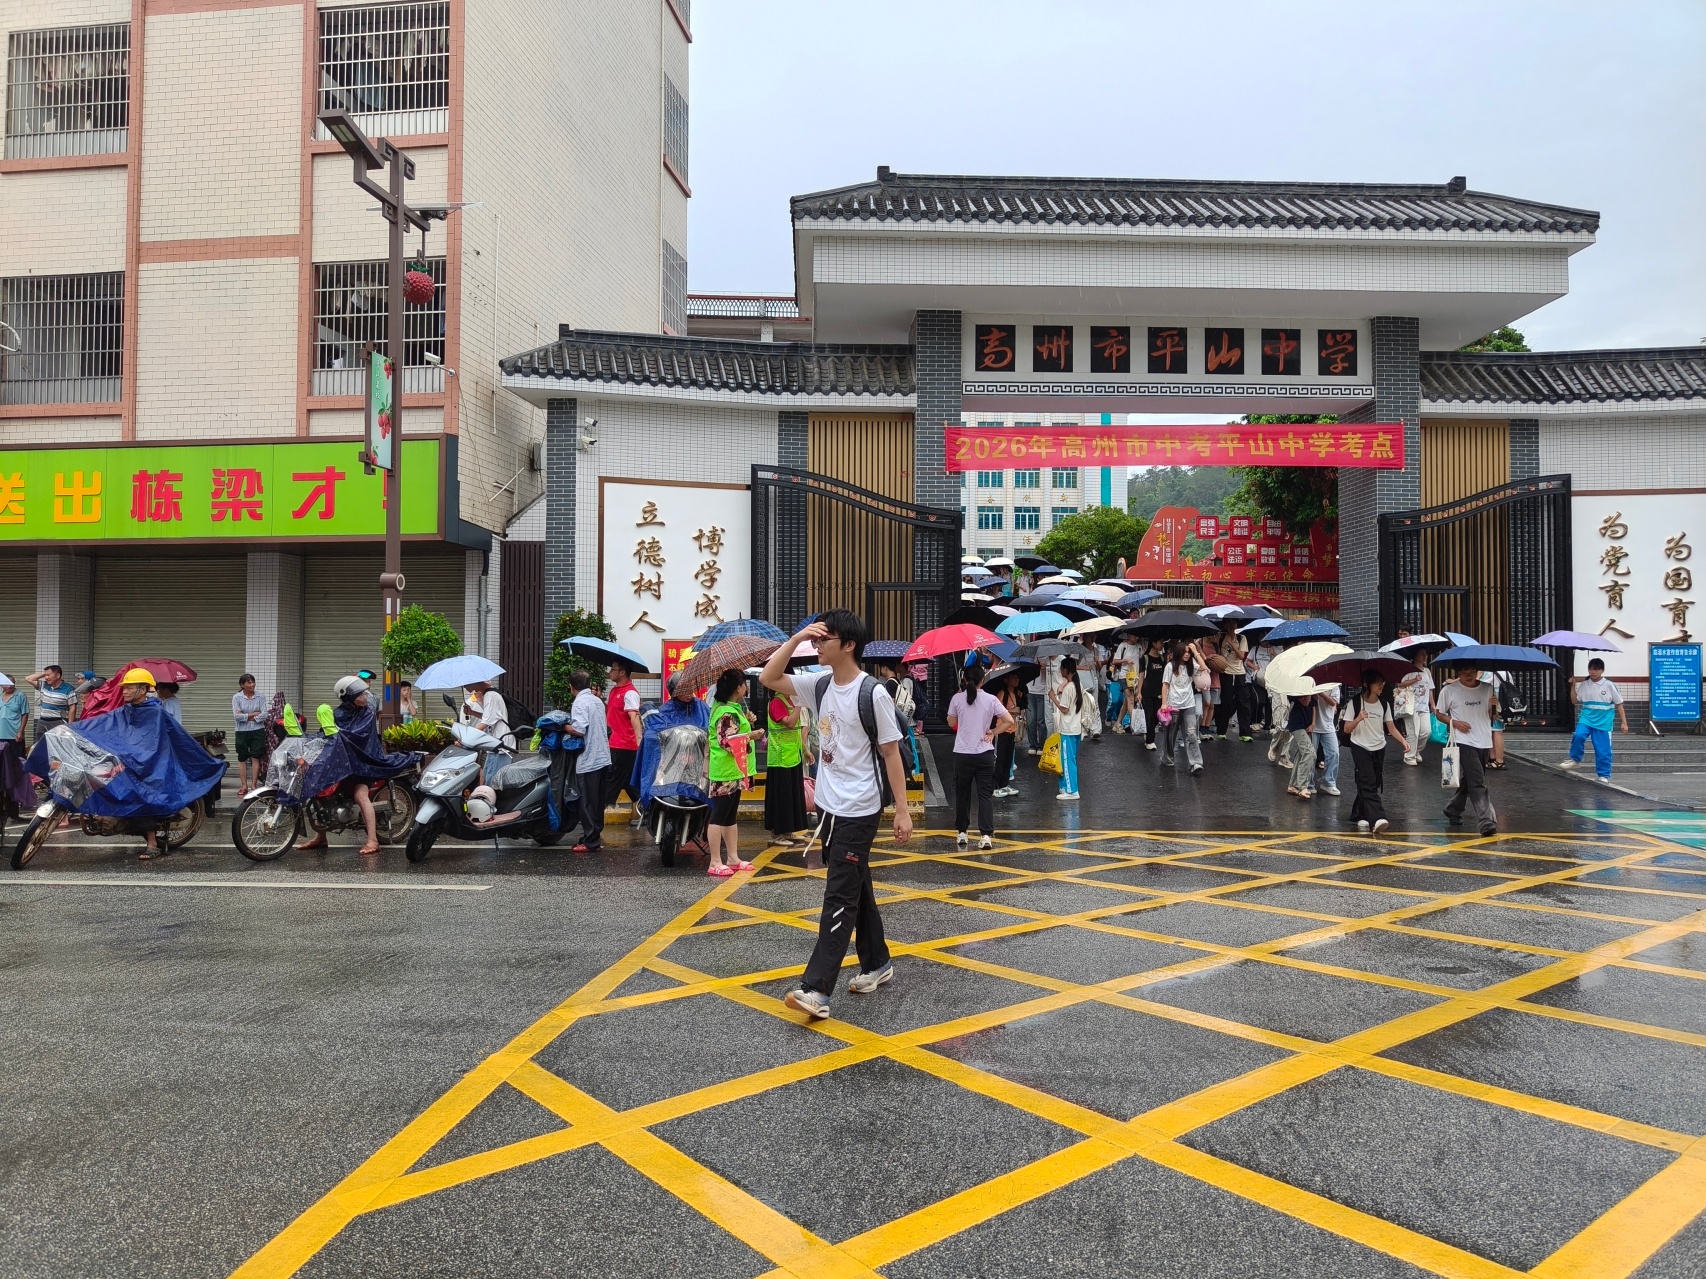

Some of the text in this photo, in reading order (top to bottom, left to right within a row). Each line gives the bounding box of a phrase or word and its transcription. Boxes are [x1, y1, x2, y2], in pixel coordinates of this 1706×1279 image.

[978, 327, 1358, 374] 高州市平山中学
[955, 431, 1395, 461] 2026年高州市中考平山中学考点
[1200, 527, 1215, 536] 民主
[1233, 519, 1249, 527] 文明
[1227, 547, 1243, 555] 公正
[629, 500, 666, 633] 立德树人
[1163, 569, 1315, 581] 不忘初心 牢记使命
[1598, 511, 1635, 639] 为党育人
[692, 526, 726, 640] 博学成
